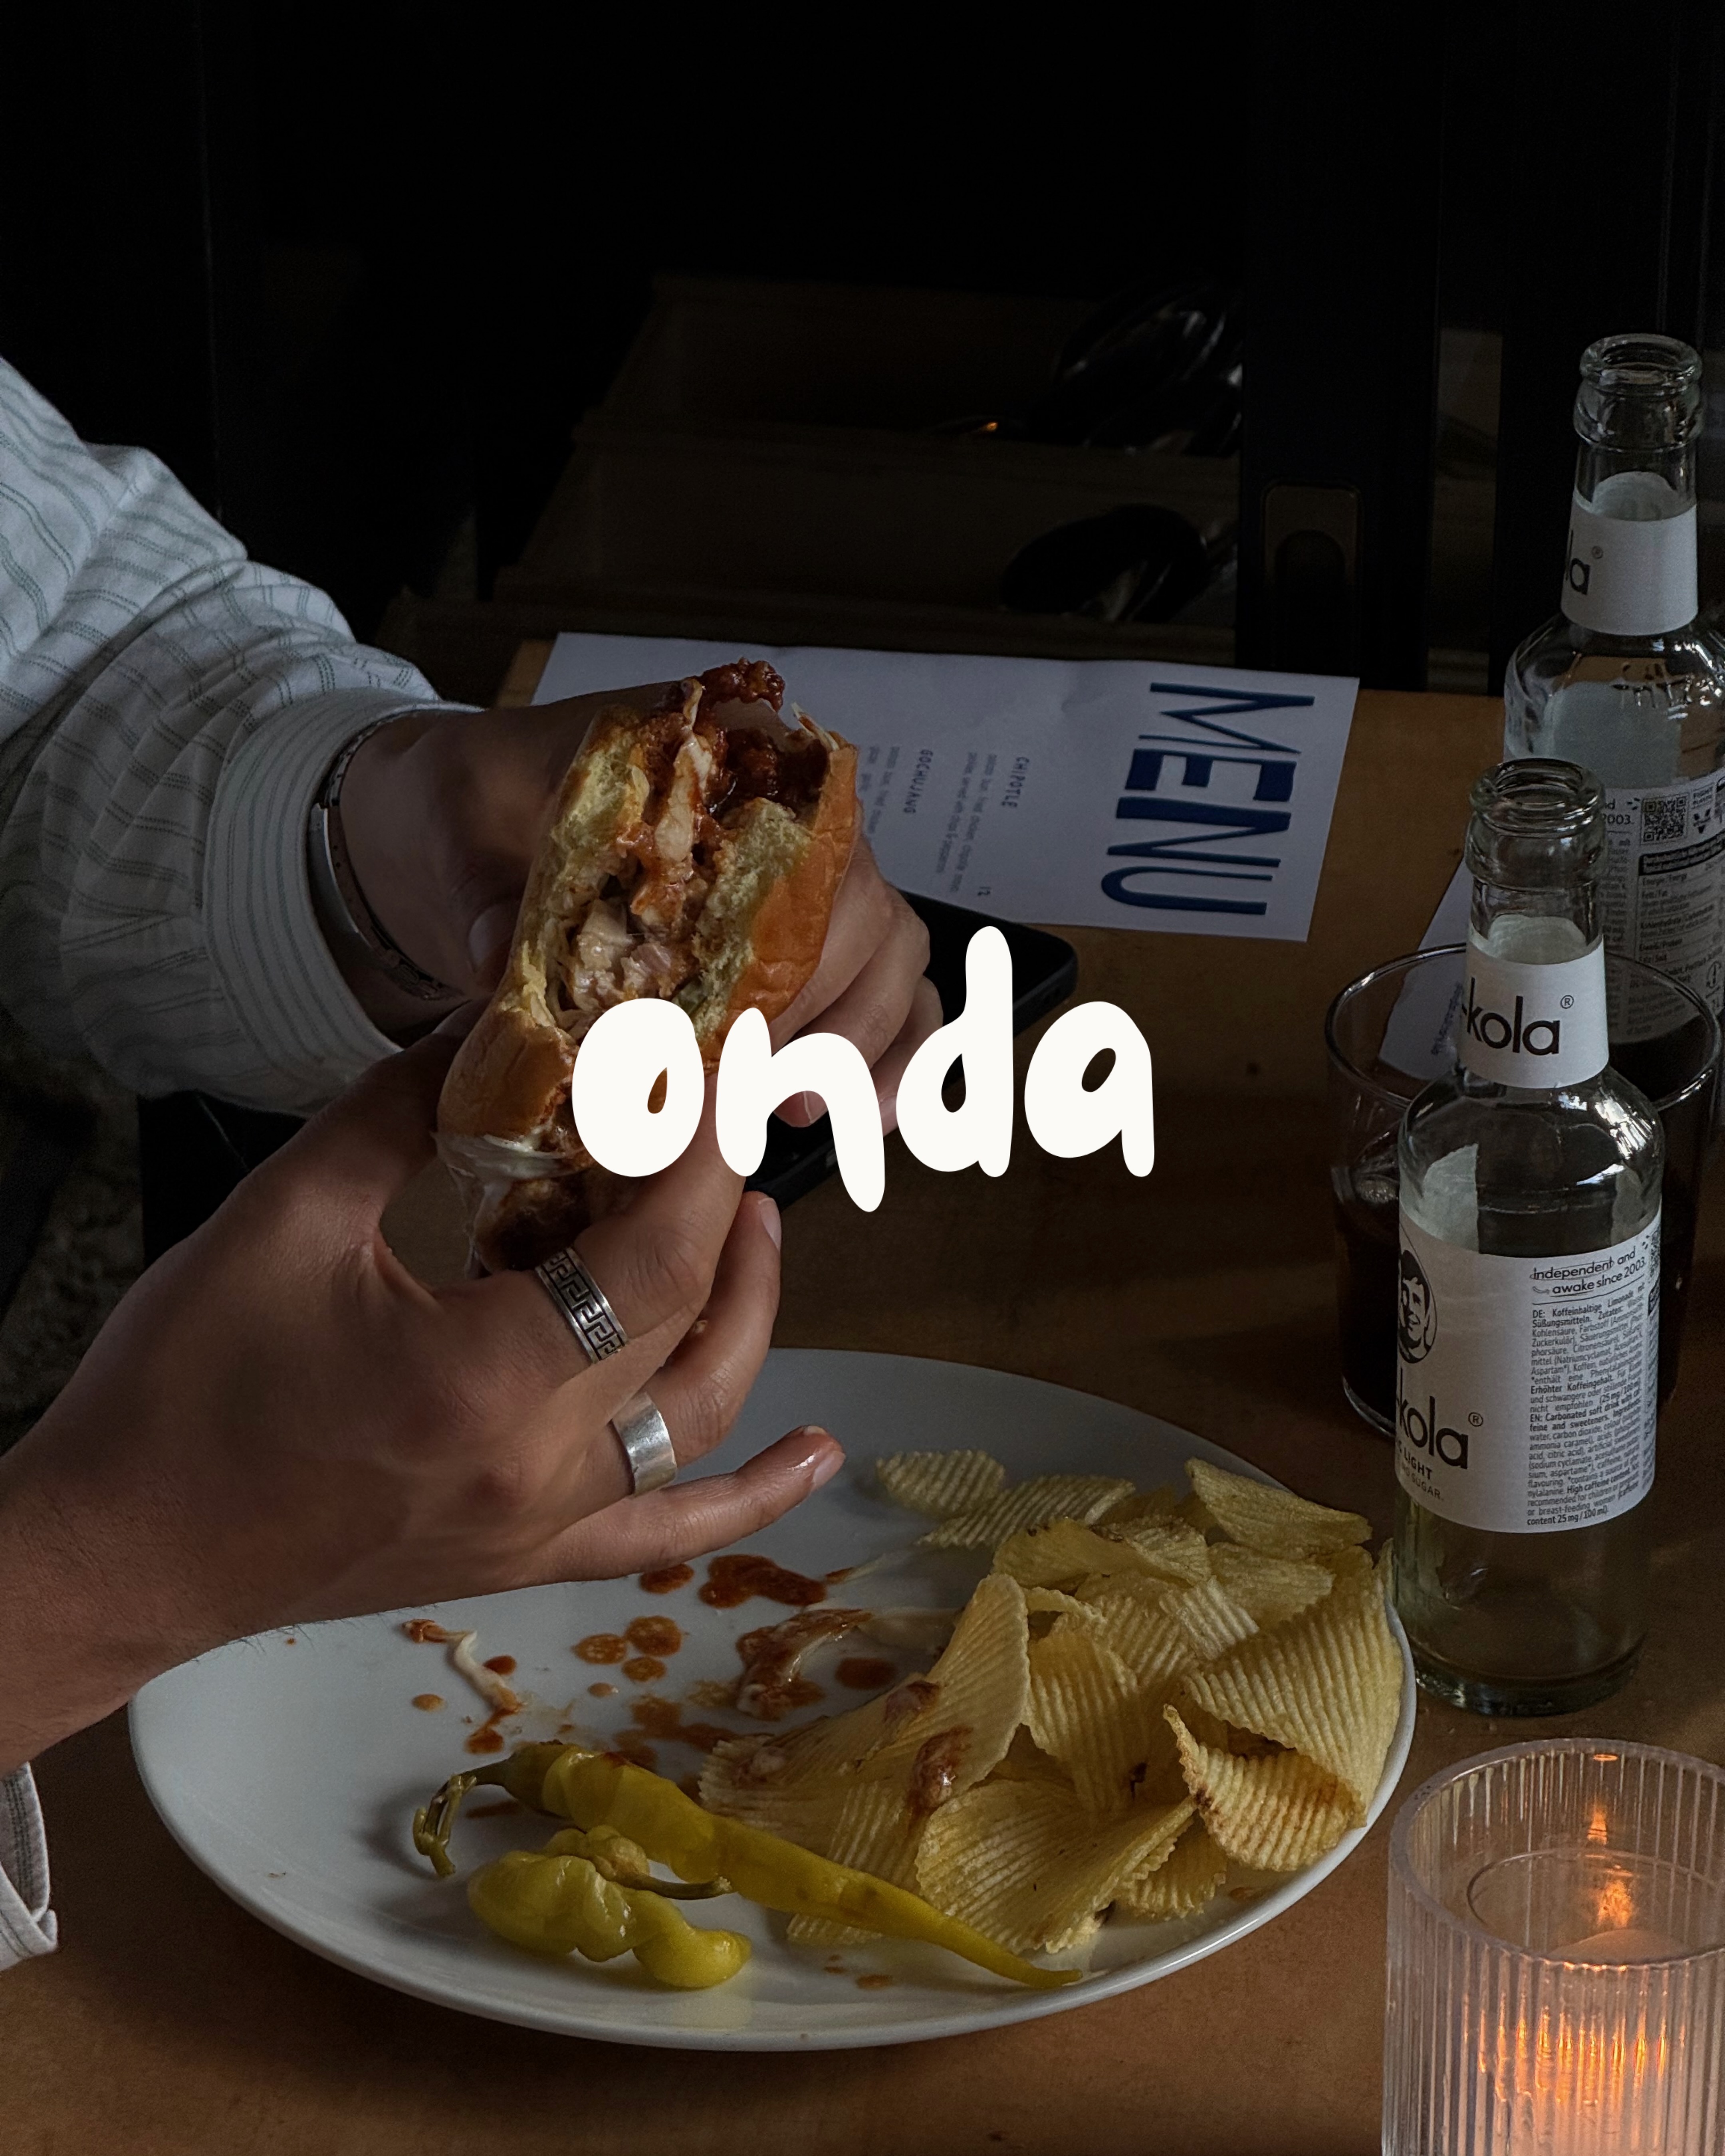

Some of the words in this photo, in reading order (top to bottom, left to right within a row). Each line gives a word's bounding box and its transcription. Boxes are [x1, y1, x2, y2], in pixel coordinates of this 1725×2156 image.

[903, 749, 934, 813] GOCHUJANG
[1001, 757, 1030, 808] CHIPOTLE
[1101, 682, 1315, 915] MENU
[1534, 1256, 1613, 1279] independent
[1618, 1246, 1636, 1264] and
[1552, 1279, 1594, 1294] awake
[1596, 1274, 1622, 1287] since
[1533, 1309, 1545, 1318] DE:
[1404, 1447, 1432, 1480] LIGHT
